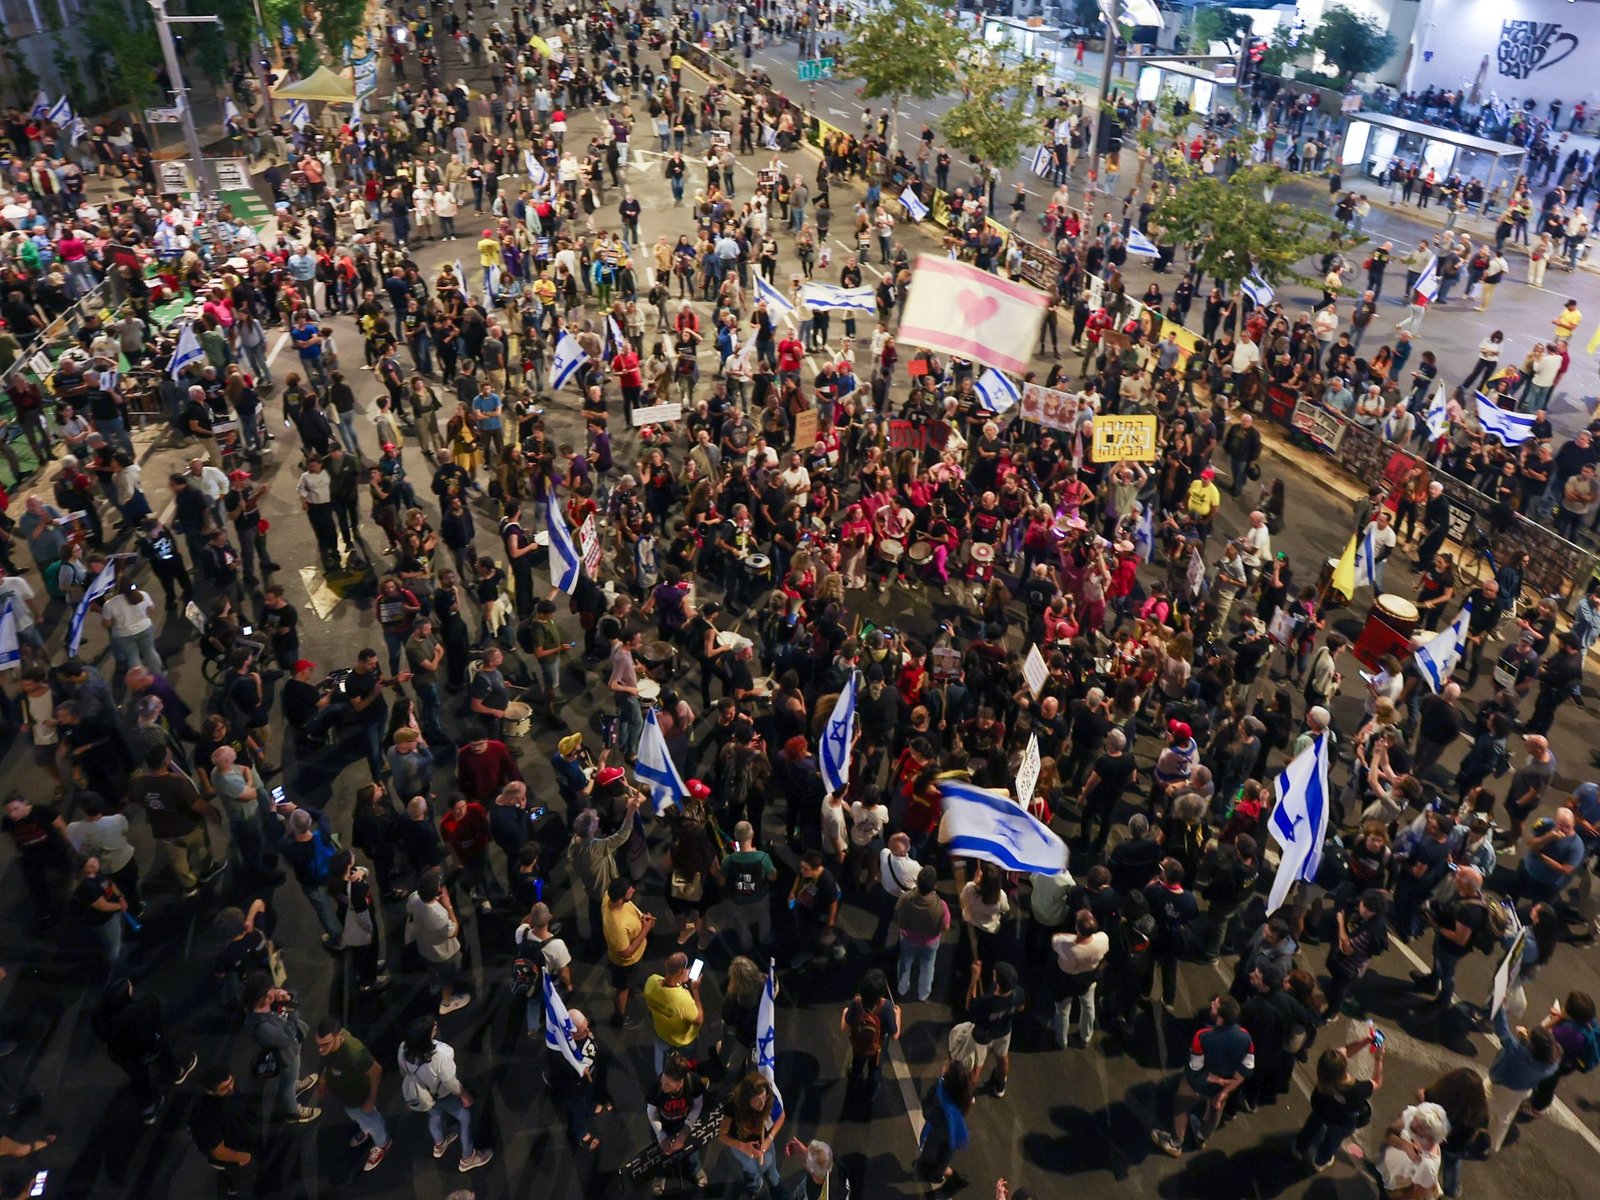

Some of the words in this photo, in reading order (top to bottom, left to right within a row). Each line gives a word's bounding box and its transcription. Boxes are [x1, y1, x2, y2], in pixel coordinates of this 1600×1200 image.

[1501, 20, 1562, 48] HAVE
[1497, 40, 1546, 65] GOOD
[1499, 60, 1536, 80] DAY
